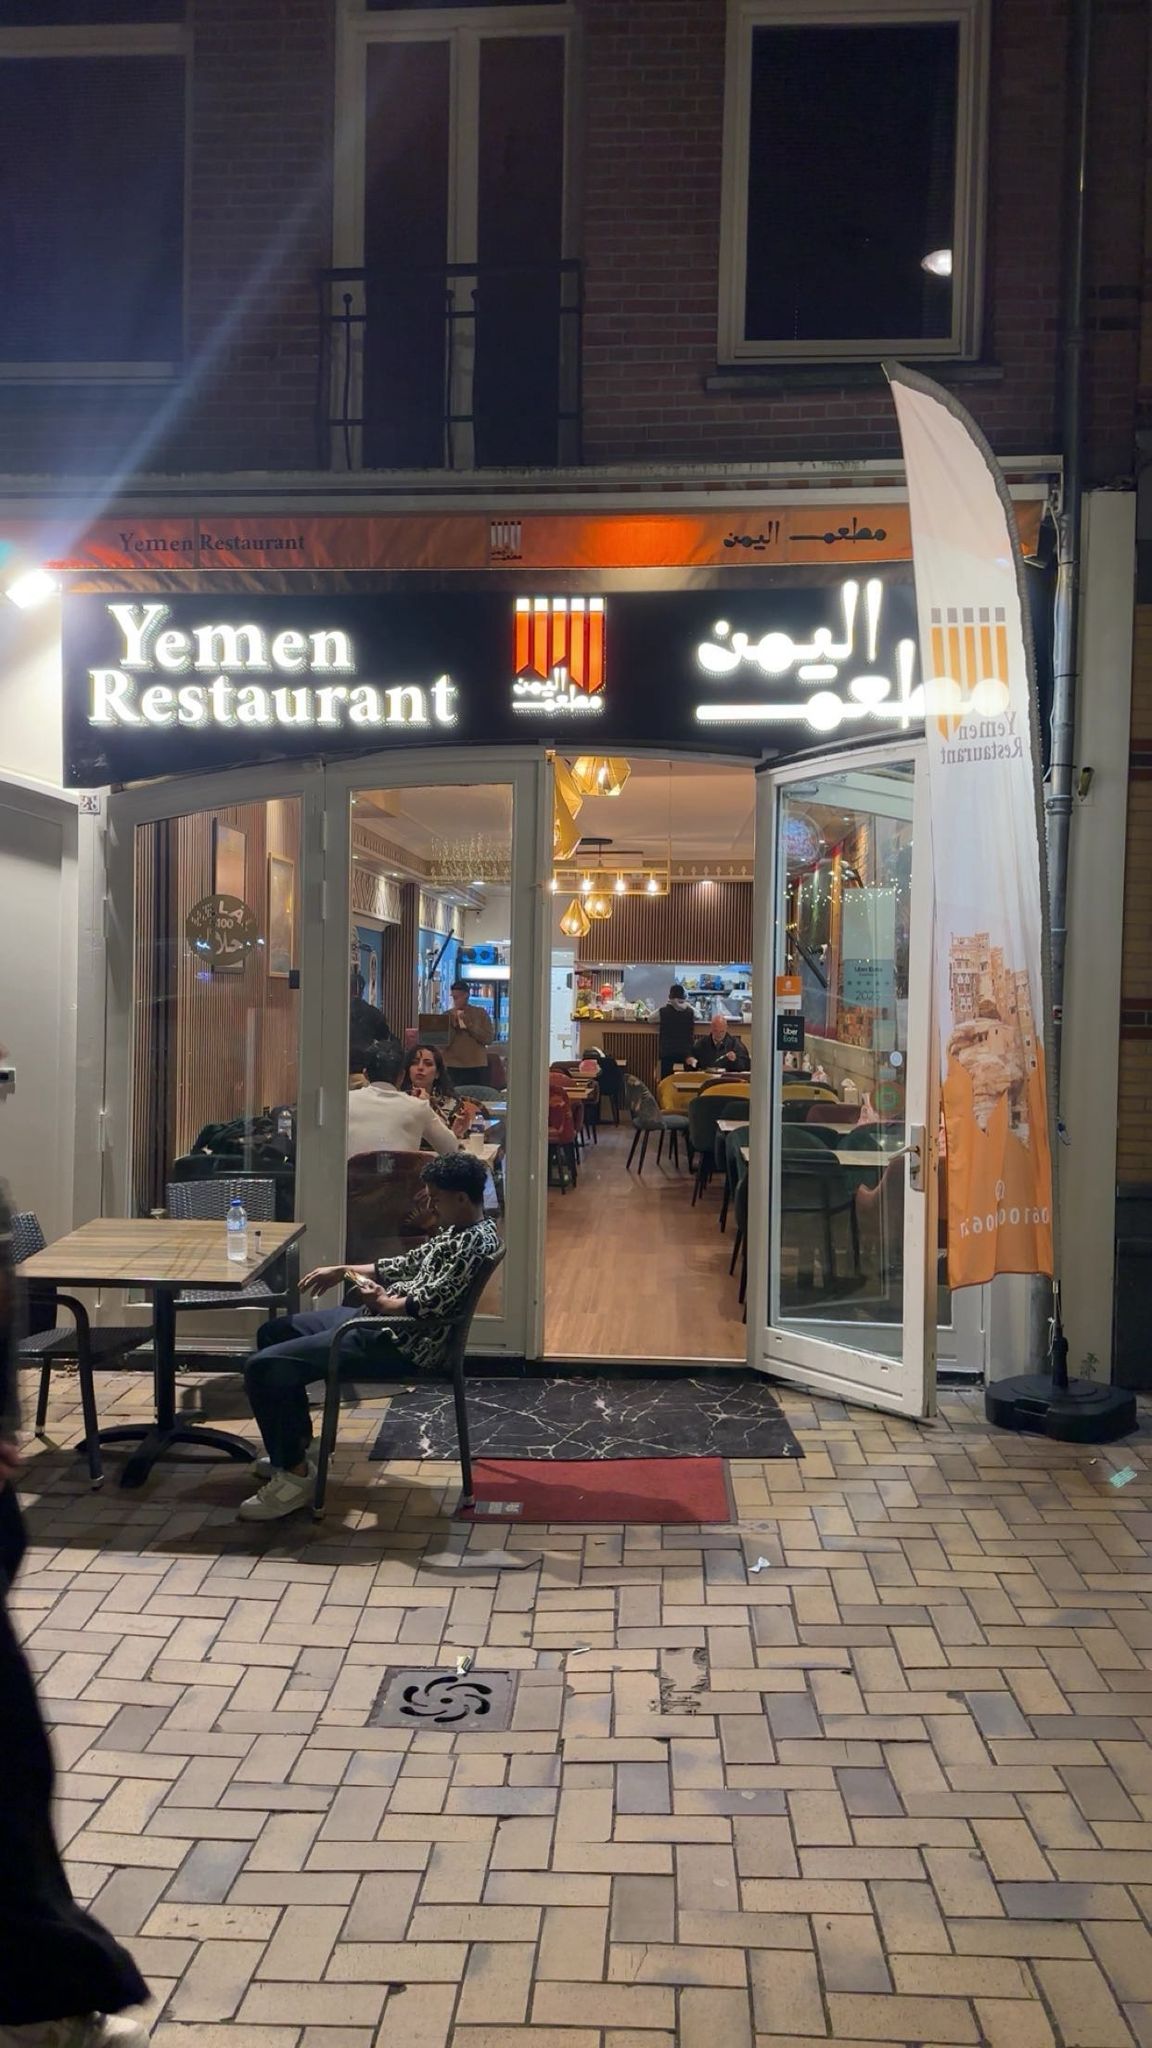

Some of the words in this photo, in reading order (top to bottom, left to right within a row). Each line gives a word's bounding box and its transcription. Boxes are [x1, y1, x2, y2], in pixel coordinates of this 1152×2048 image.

[119, 531, 193, 552] Yemen
[200, 533, 305, 551] Restaurant
[723, 520, 780, 551] اليمن
[789, 516, 887, 544] مطعم
[106, 603, 354, 671] Yemen
[697, 578, 883, 682] اليمن
[88, 668, 459, 726] Restaurant
[512, 666, 568, 698] اليمن
[783, 1027, 799, 1036] Uber
